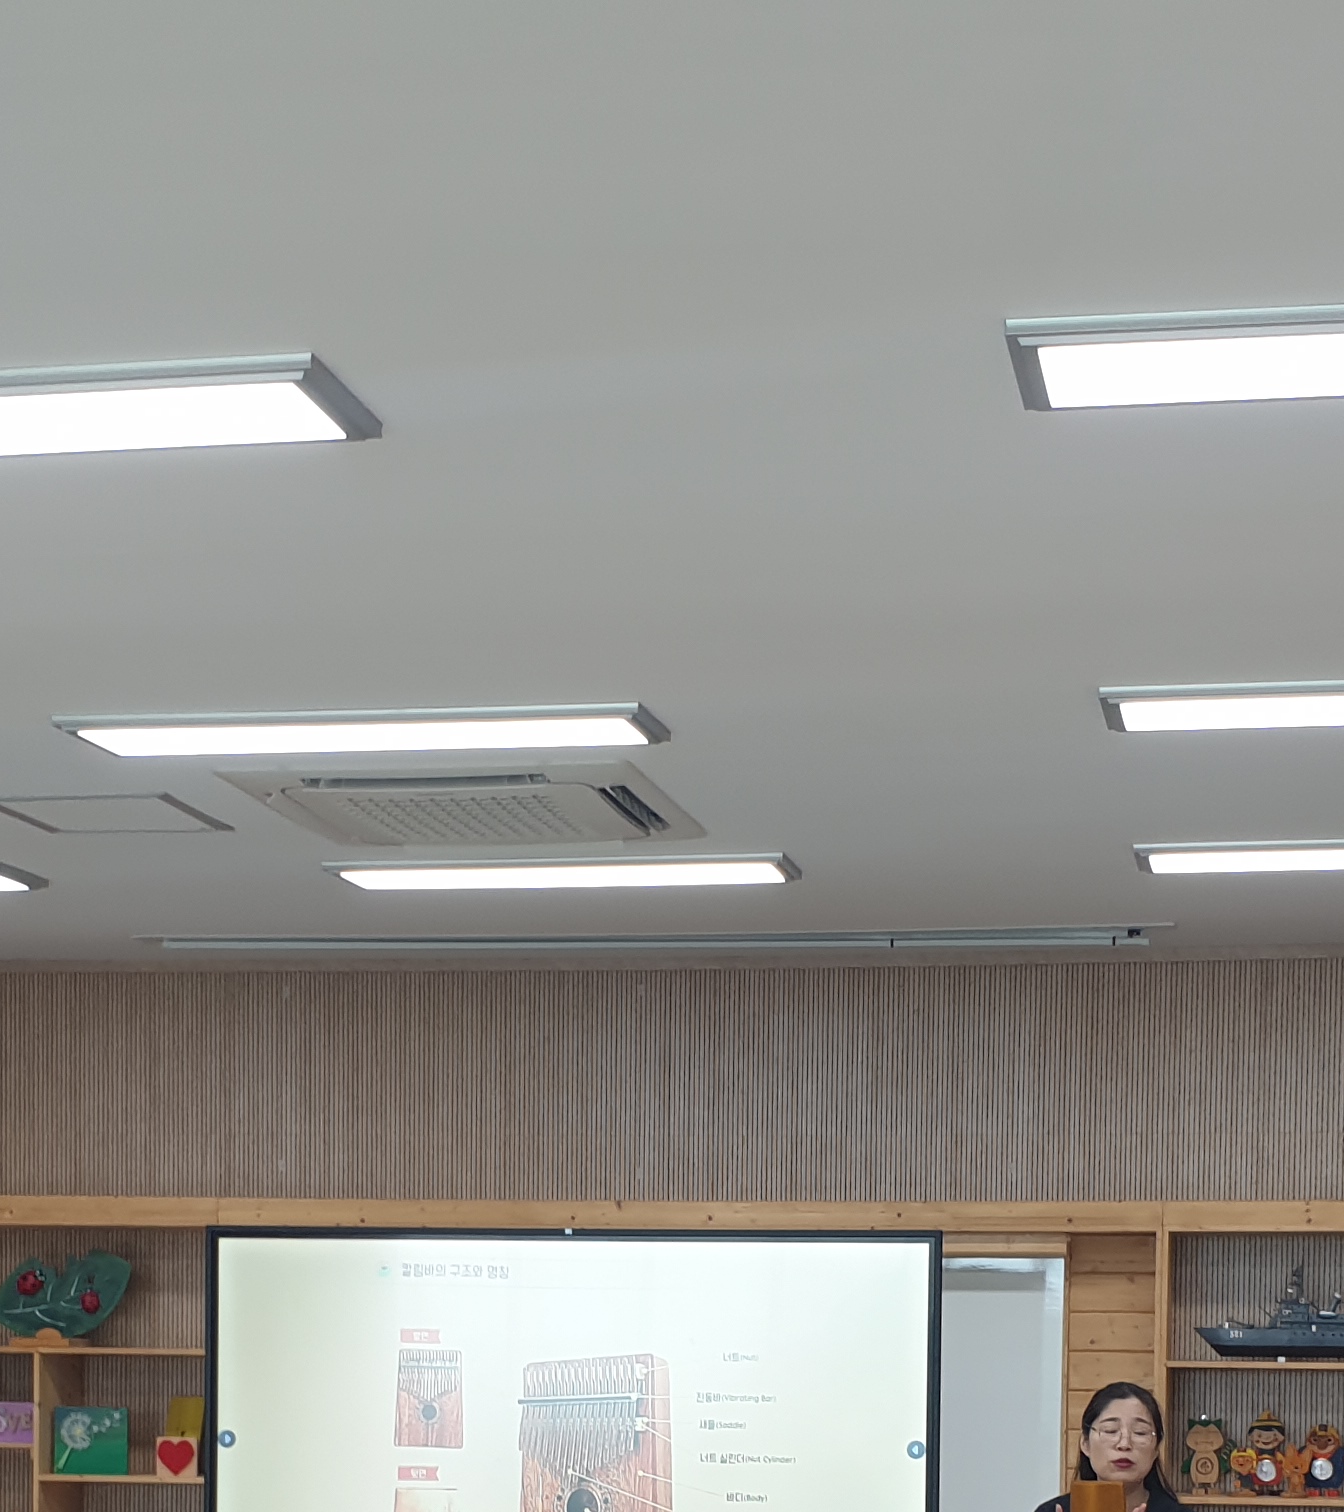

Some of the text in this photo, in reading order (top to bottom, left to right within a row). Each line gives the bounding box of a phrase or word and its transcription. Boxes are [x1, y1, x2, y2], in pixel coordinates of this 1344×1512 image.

[402, 1263, 509, 1279] 칼림바의 구조와 명칭
